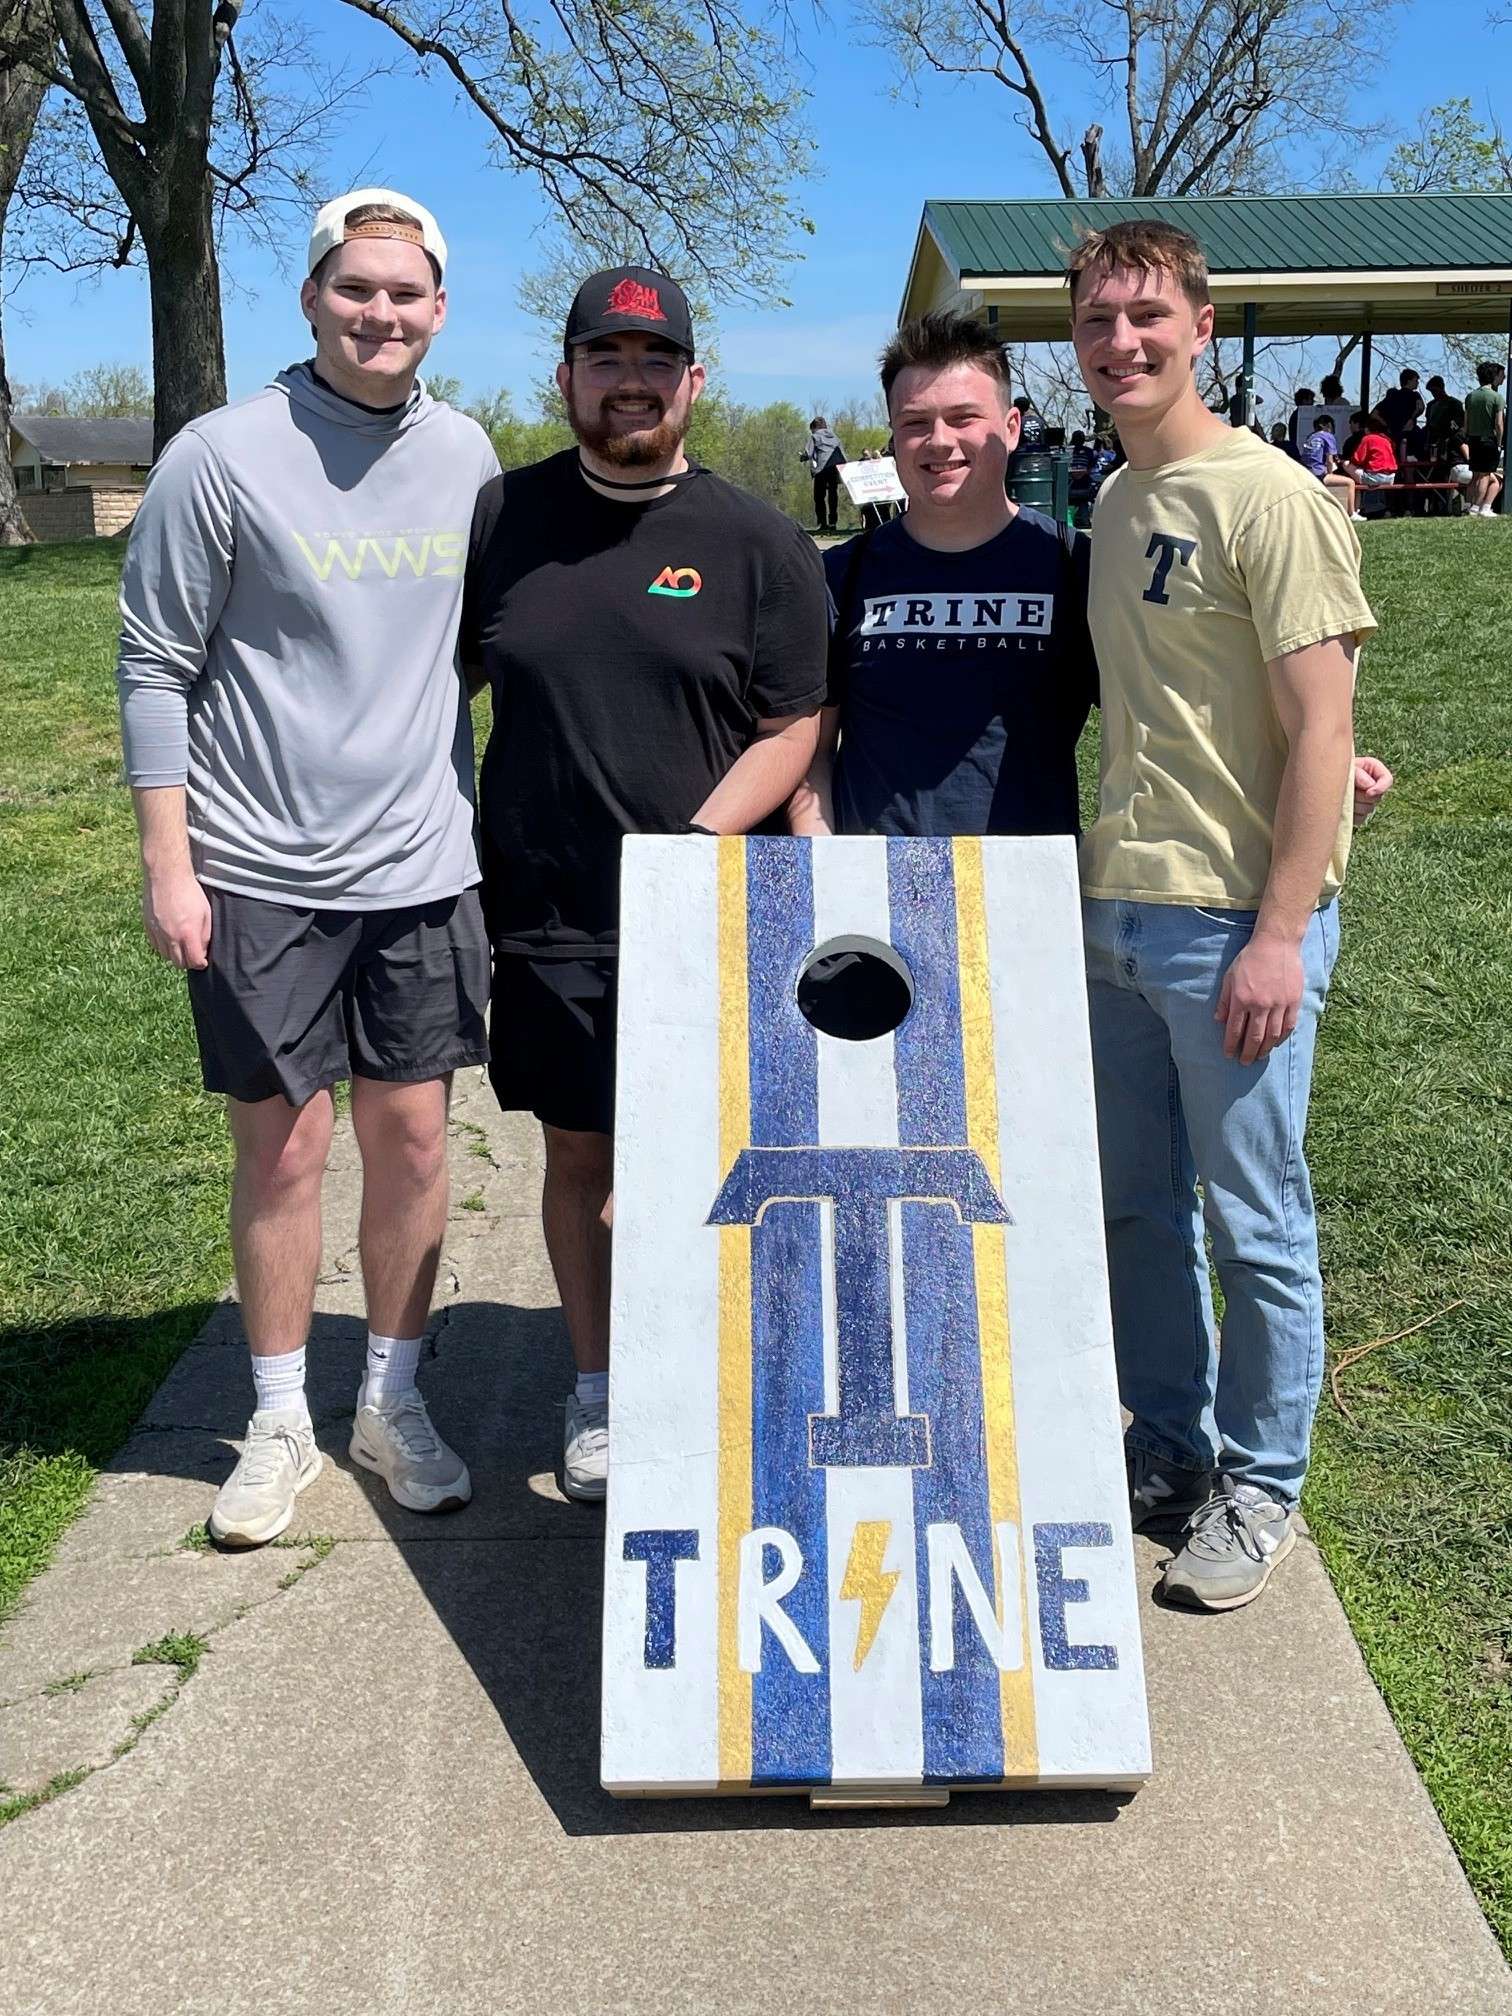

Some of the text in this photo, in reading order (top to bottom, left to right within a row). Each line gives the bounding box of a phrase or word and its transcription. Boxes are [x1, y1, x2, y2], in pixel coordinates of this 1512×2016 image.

[1142, 532, 1198, 606] T
[872, 599, 1046, 628] TRINE
[862, 637, 1045, 652] BASKETBALL
